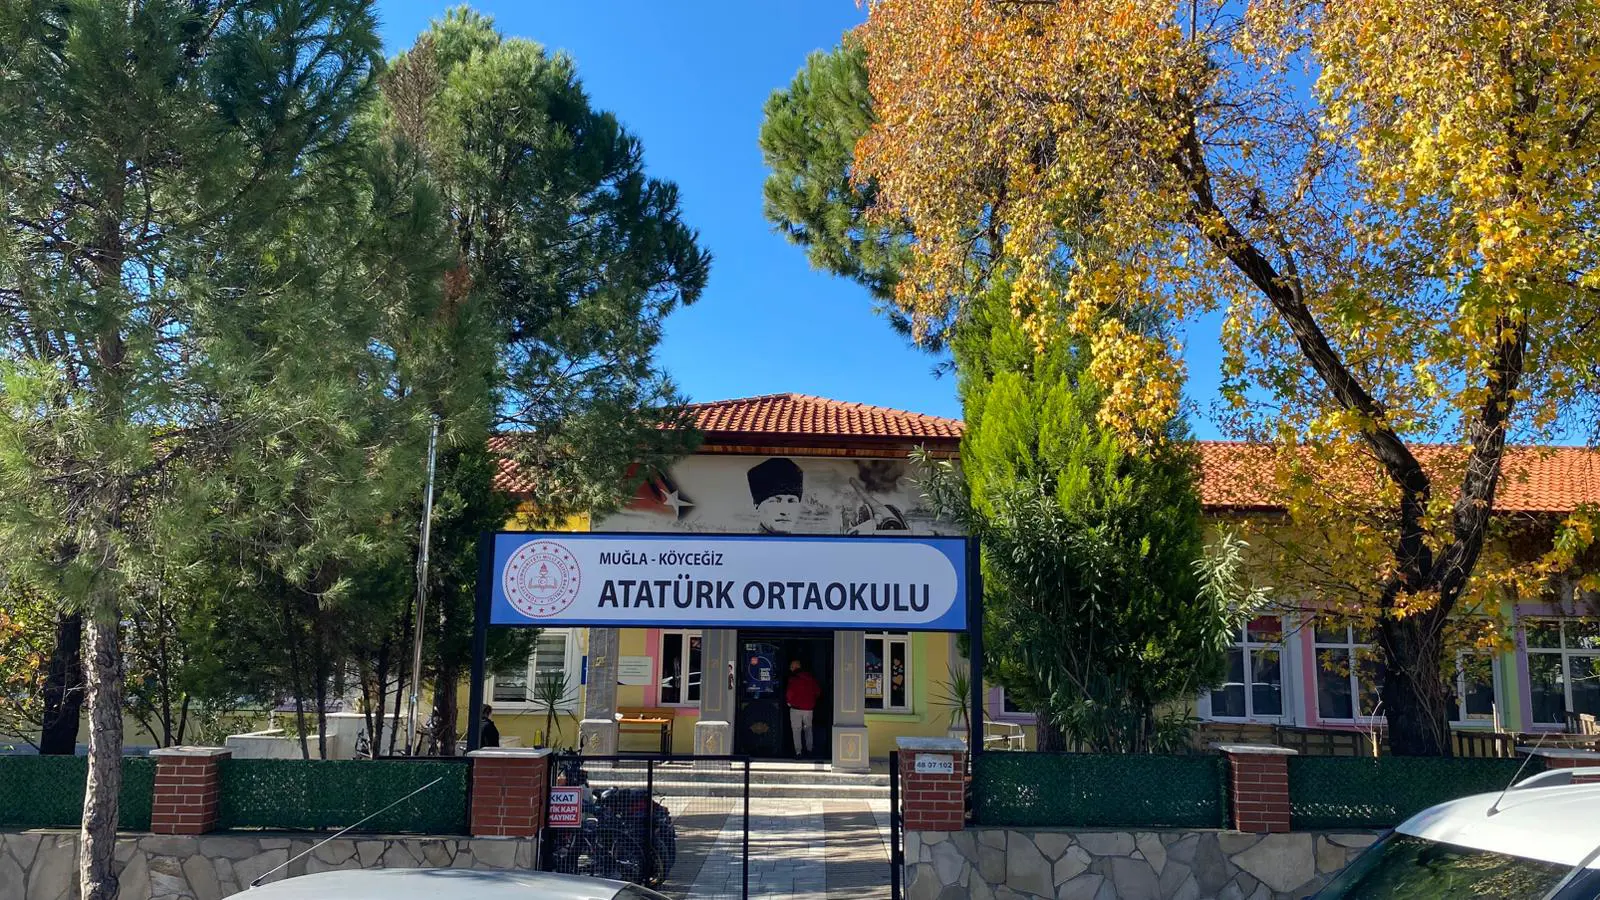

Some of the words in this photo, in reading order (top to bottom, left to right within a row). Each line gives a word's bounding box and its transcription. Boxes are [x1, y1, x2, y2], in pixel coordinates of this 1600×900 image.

[599, 550, 648, 565] MUĞLA
[659, 550, 723, 566] KÖYCEĞİZ
[597, 574, 735, 609] ATATÜRK
[742, 581, 930, 612] ORTAOKULU
[927, 761, 937, 769] 07
[939, 761, 952, 769] 102
